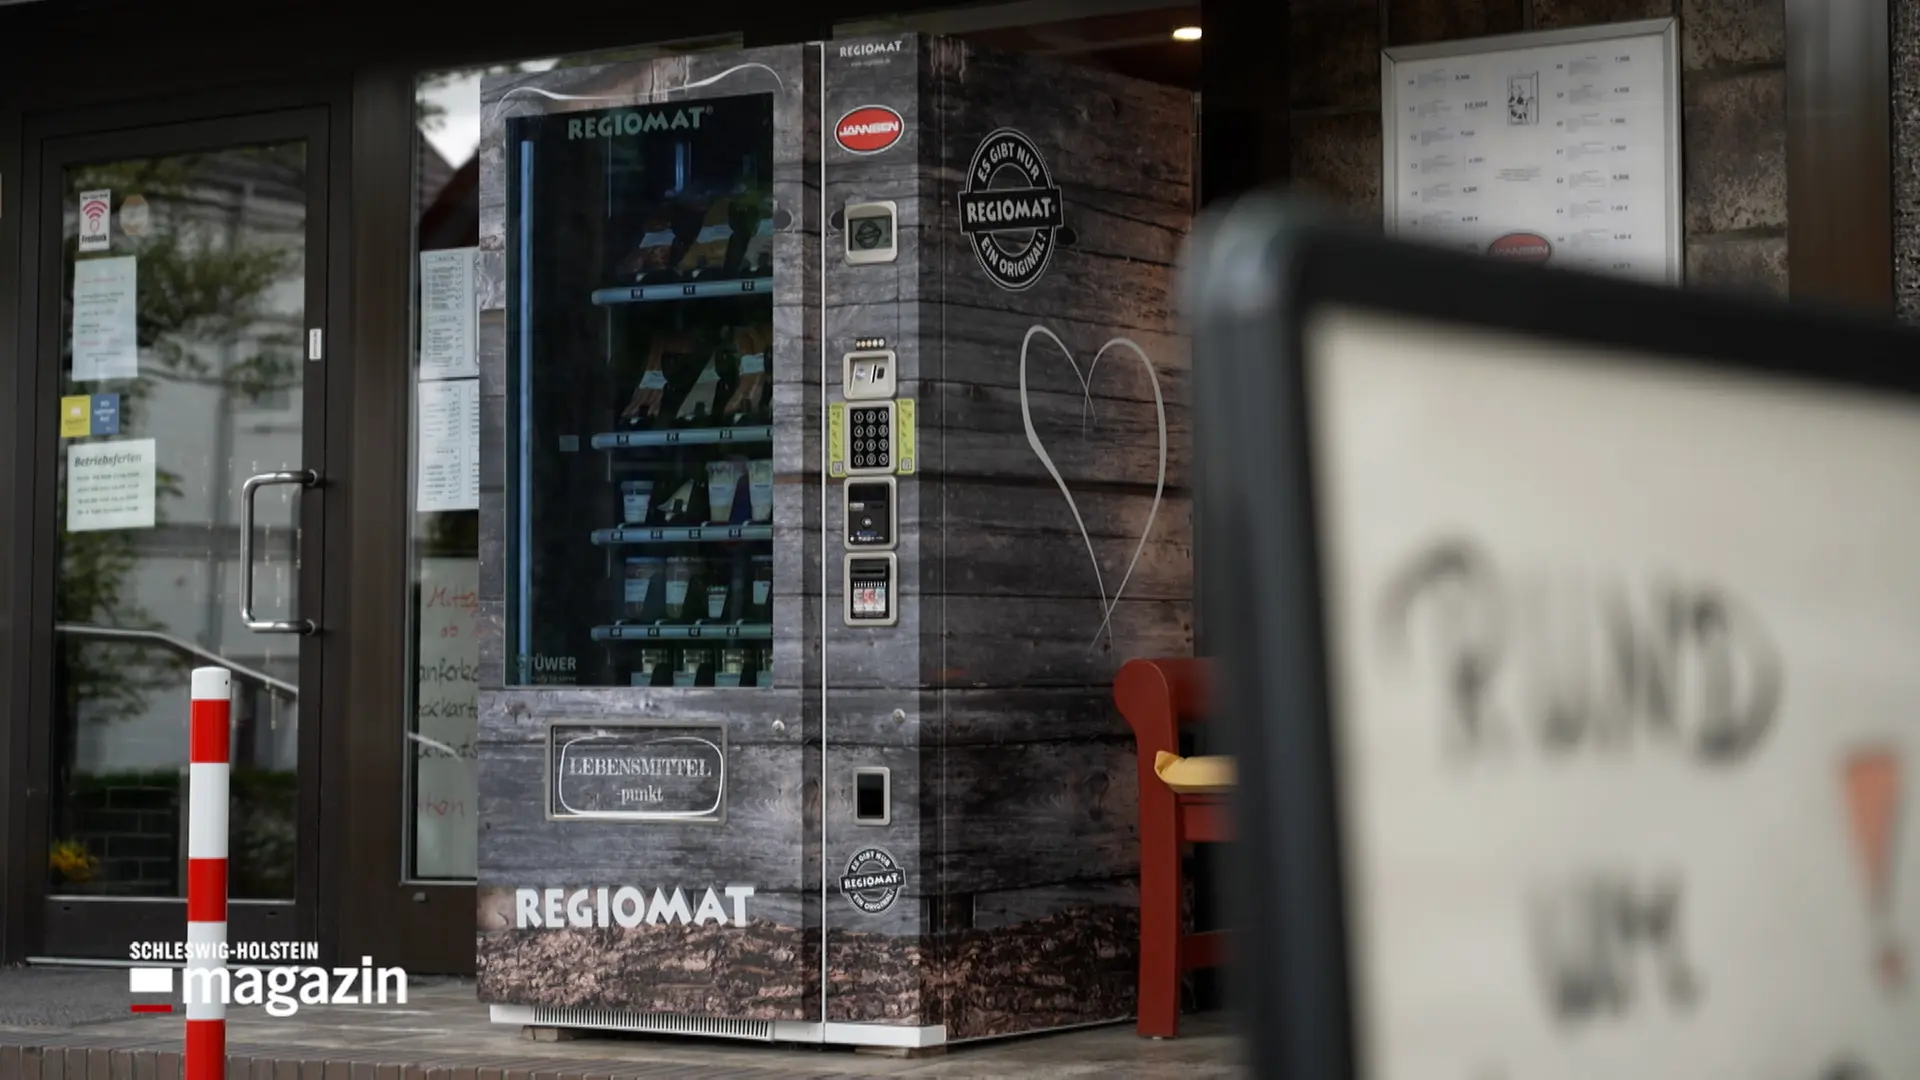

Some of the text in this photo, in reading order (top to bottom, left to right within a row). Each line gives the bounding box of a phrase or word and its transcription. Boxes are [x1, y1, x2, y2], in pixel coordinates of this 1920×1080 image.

[840, 40, 902, 57] REGIOMAT
[977, 142, 1040, 183] ES GIBT NUR
[981, 236, 999, 266] EIN
[569, 757, 712, 777] LEBENSMITTEL
[515, 886, 755, 928] REGIOMAT
